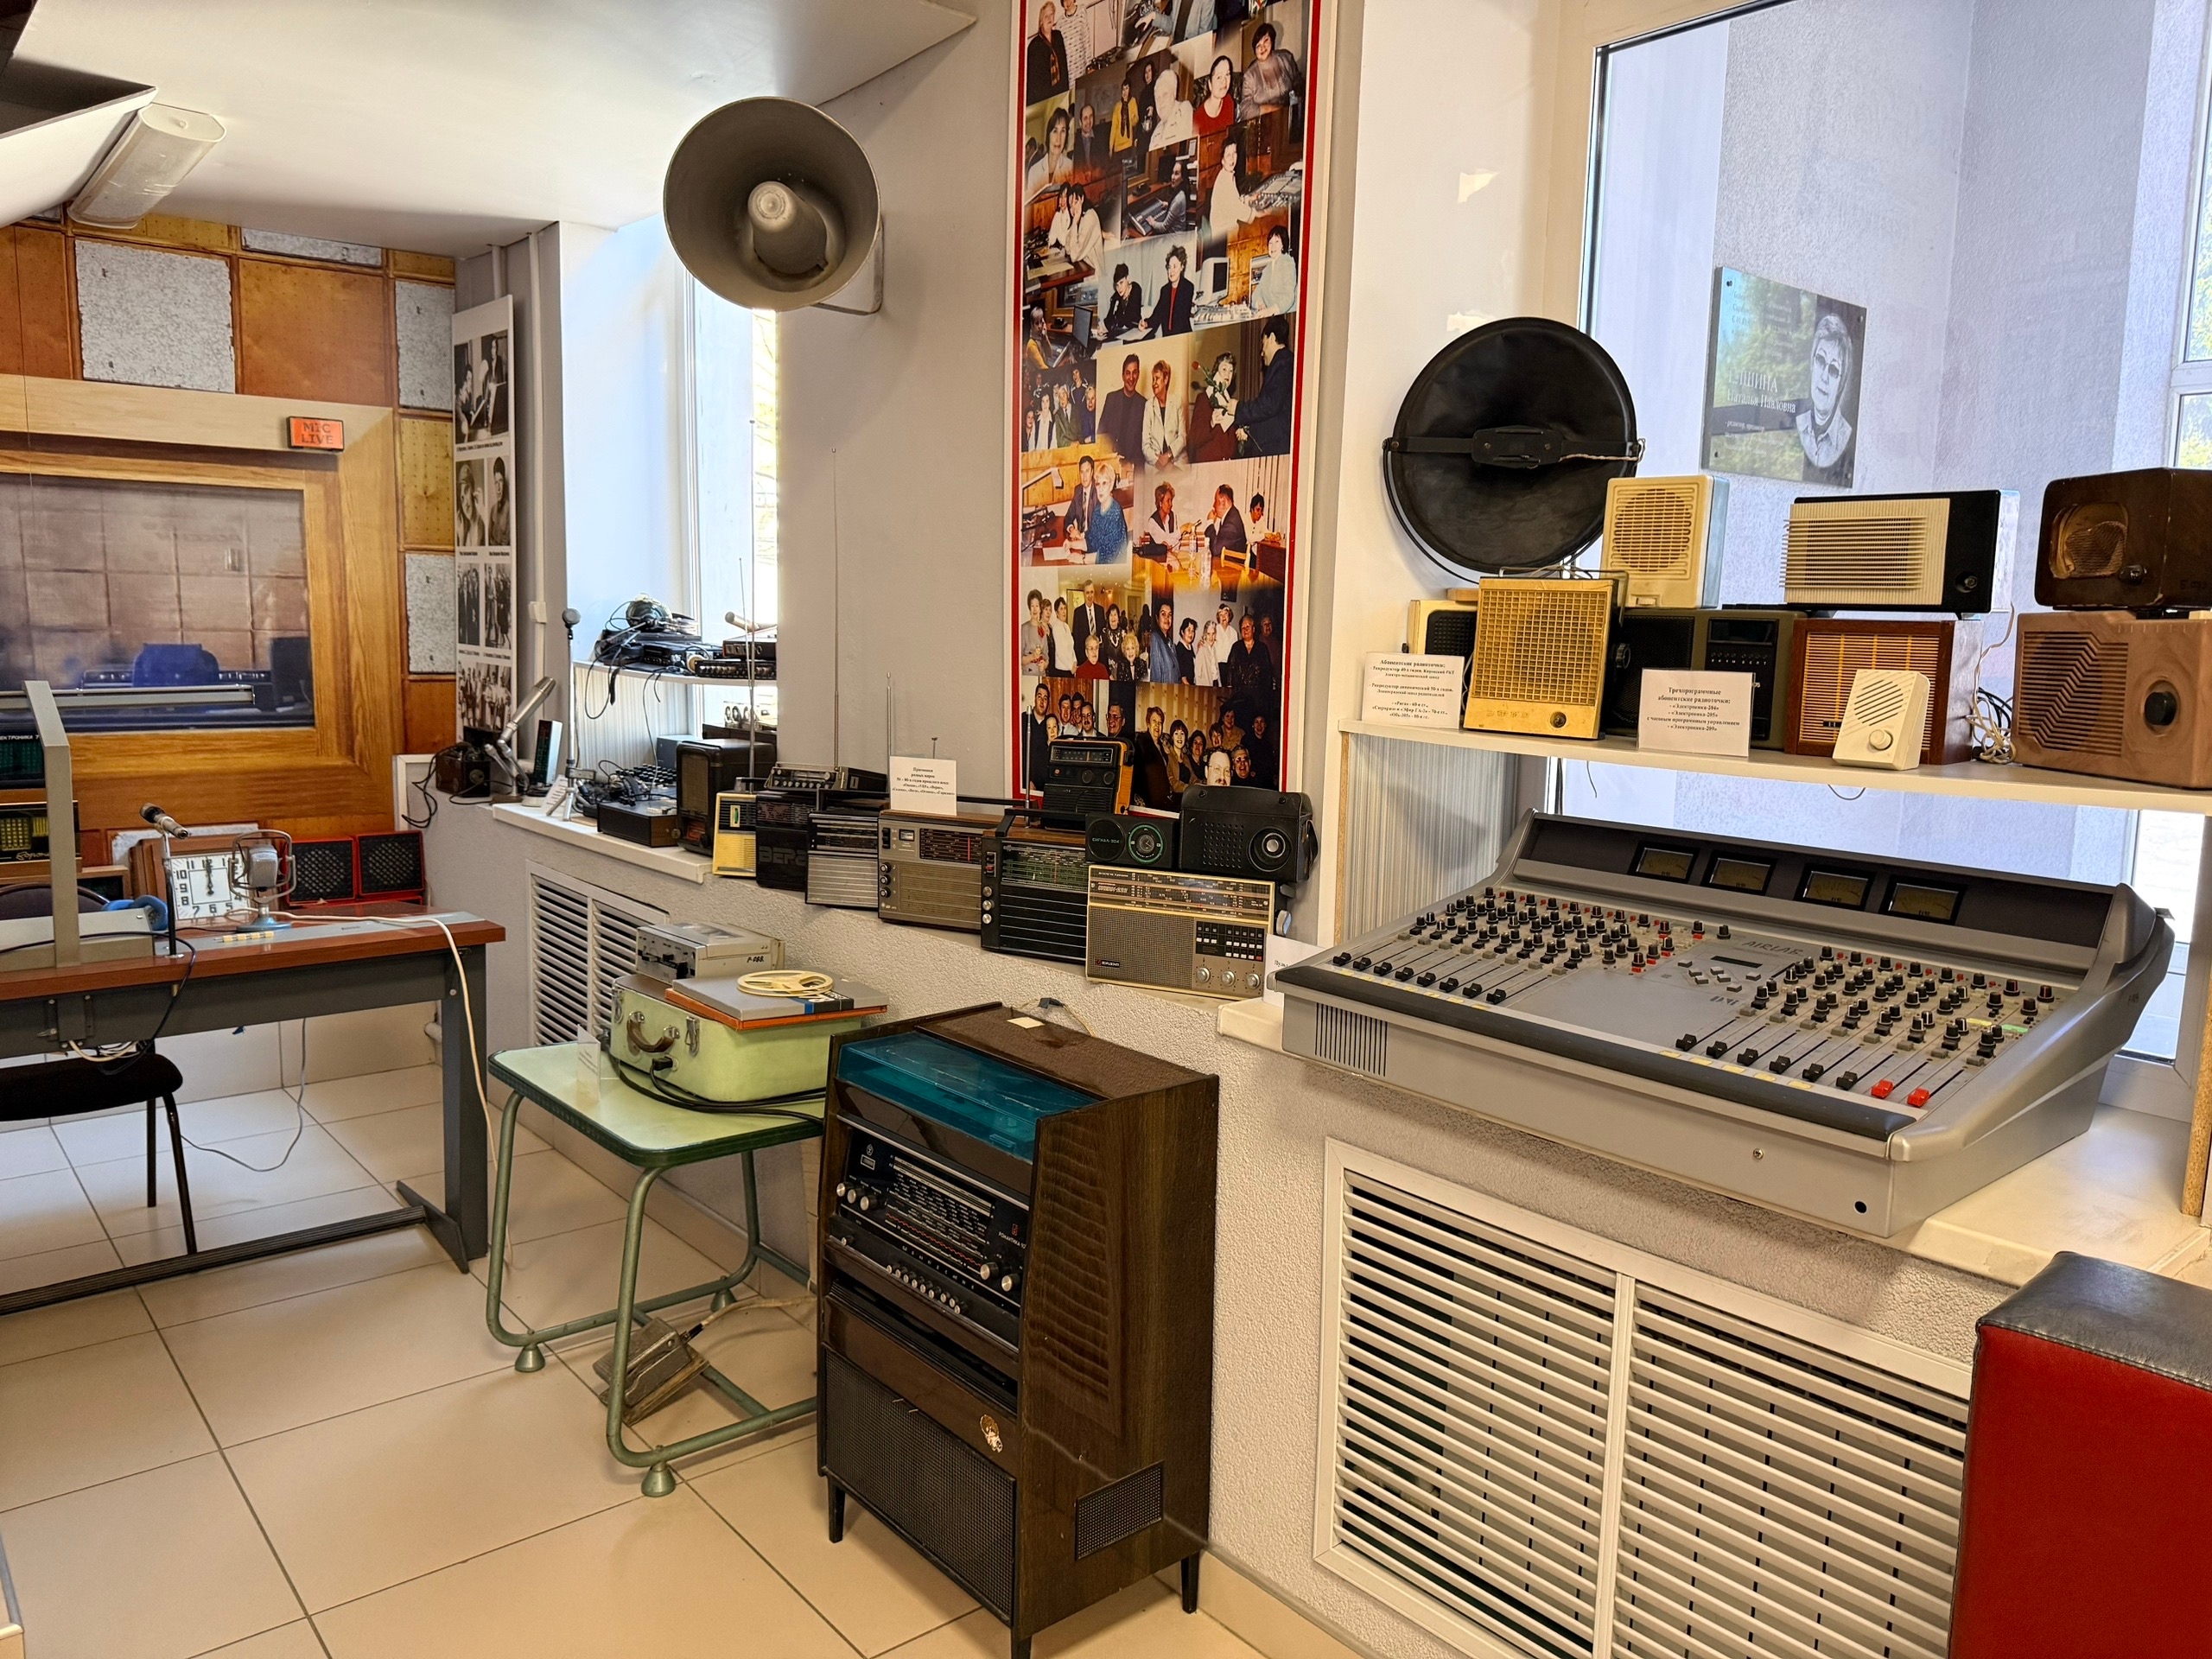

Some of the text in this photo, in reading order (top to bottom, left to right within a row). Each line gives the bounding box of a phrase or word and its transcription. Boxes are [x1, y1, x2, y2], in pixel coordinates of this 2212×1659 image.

[1760, 394, 1796, 414] Павловна
[303, 423, 331, 434] MIC
[301, 434, 334, 445] LIVE
[759, 846, 807, 866] ВЕРА
[187, 860, 194, 869] 11
[176, 869, 188, 880] 10
[179, 883, 188, 893] 9
[181, 896, 189, 906] 8
[192, 906, 200, 915] 7
[209, 904, 217, 913] 6
[226, 902, 233, 912] 5
[1741, 941, 1804, 957] AIRLAB
[998, 1230, 1020, 1246] РОМАНТИКА
